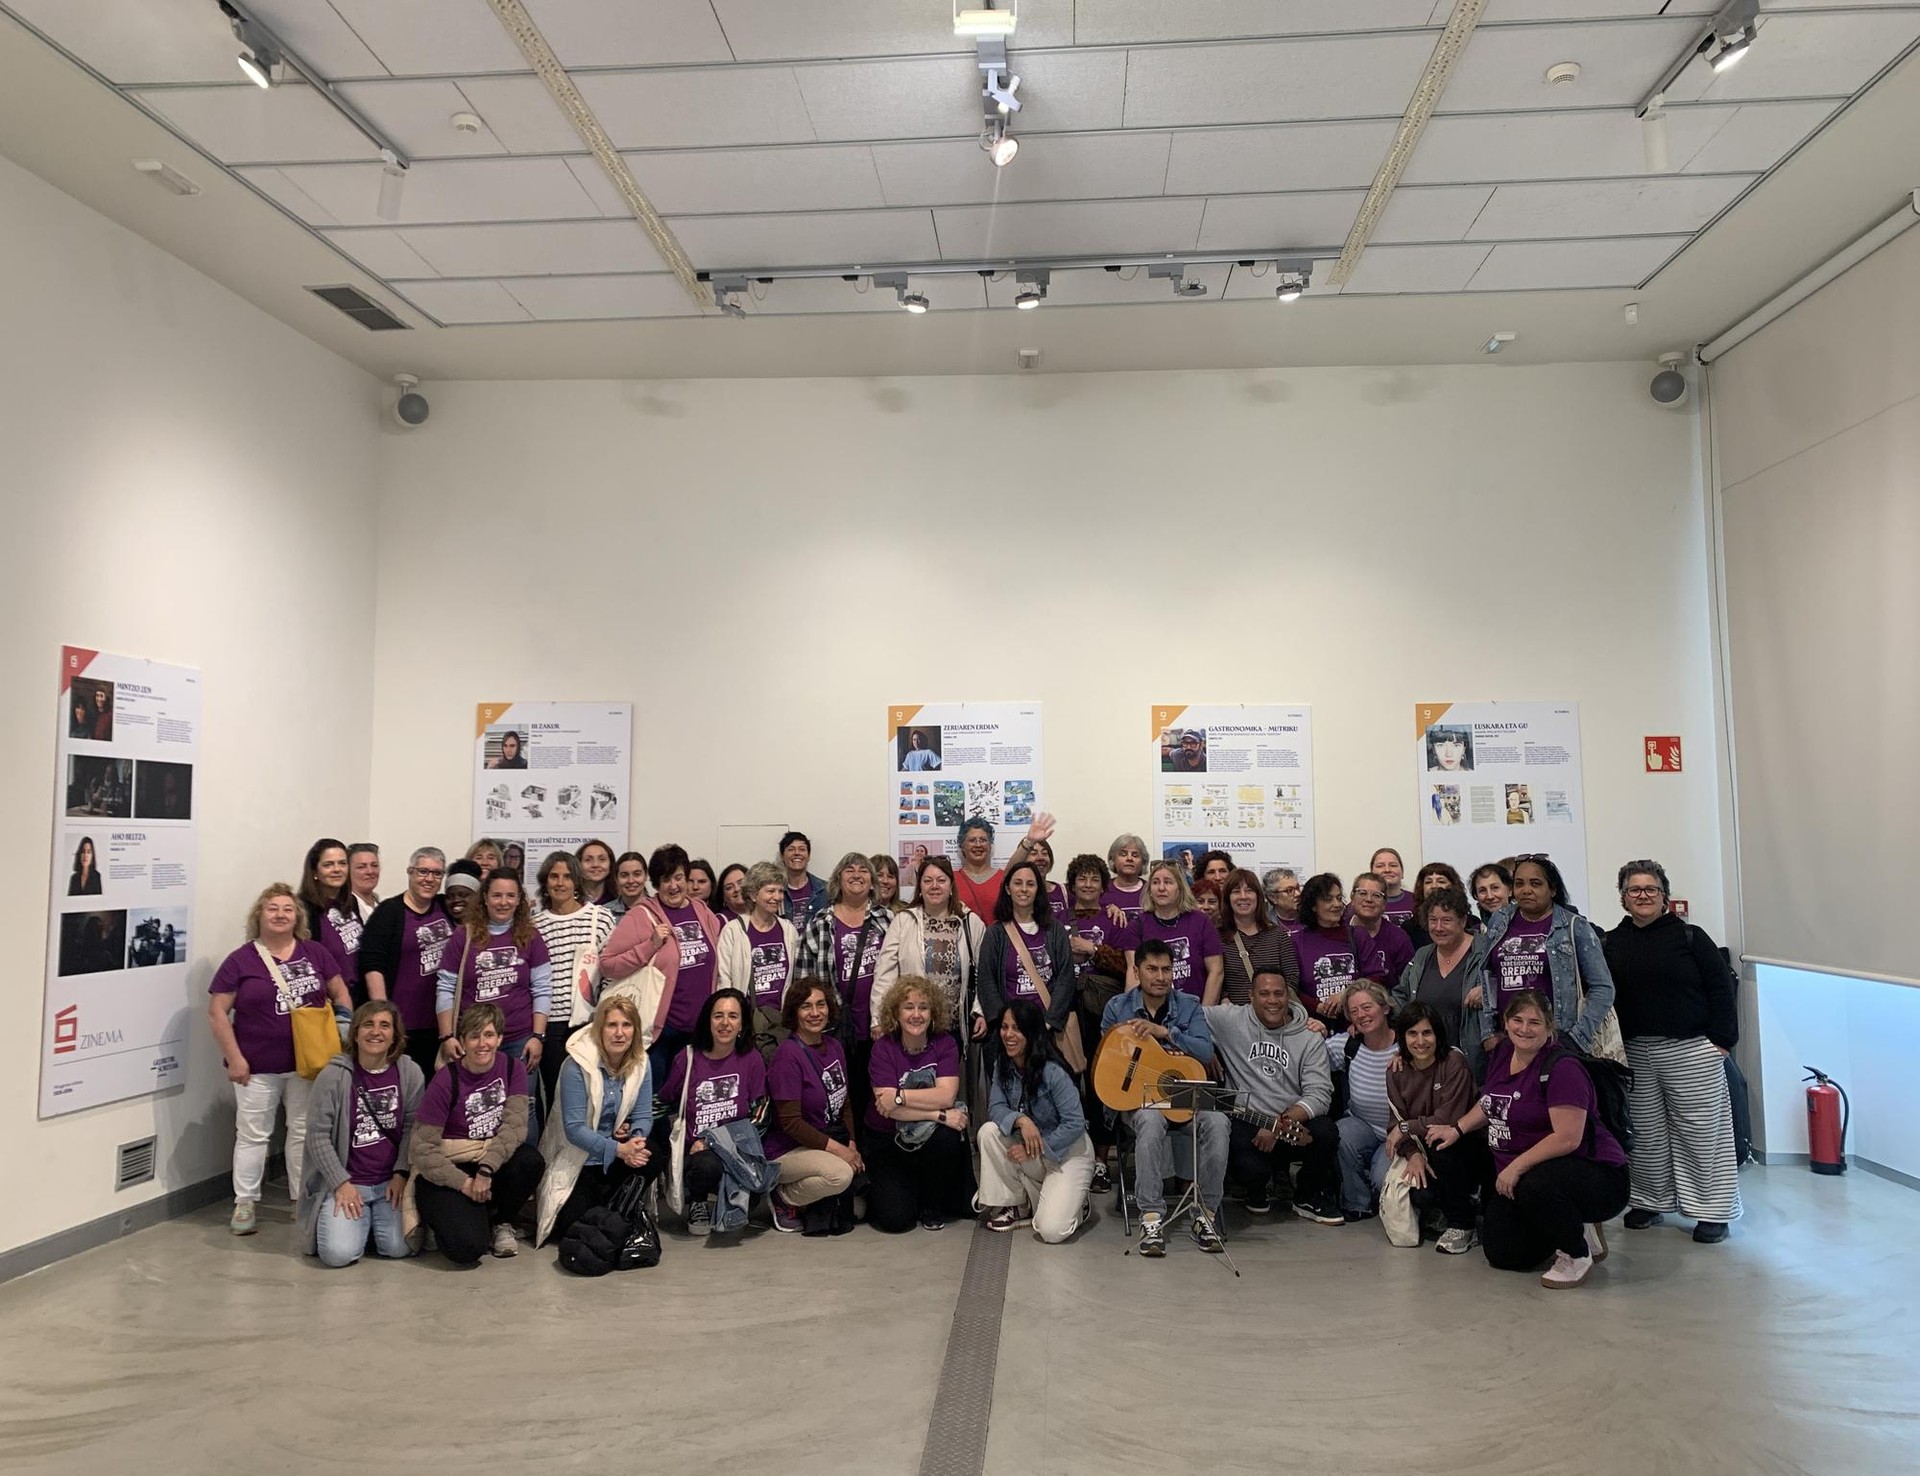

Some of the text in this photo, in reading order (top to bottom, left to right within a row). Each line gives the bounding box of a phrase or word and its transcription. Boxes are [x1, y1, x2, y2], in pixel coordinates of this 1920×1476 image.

[681, 944, 710, 958] REBAN!
[1501, 966, 1544, 977] GREBAN!
[477, 976, 518, 990] GREBAN!
[1316, 985, 1346, 998] GREBA
[80, 1029, 124, 1050] ZINEMA
[1248, 1041, 1289, 1070] ADIDAS
[695, 1109, 738, 1125] GREBAN!
